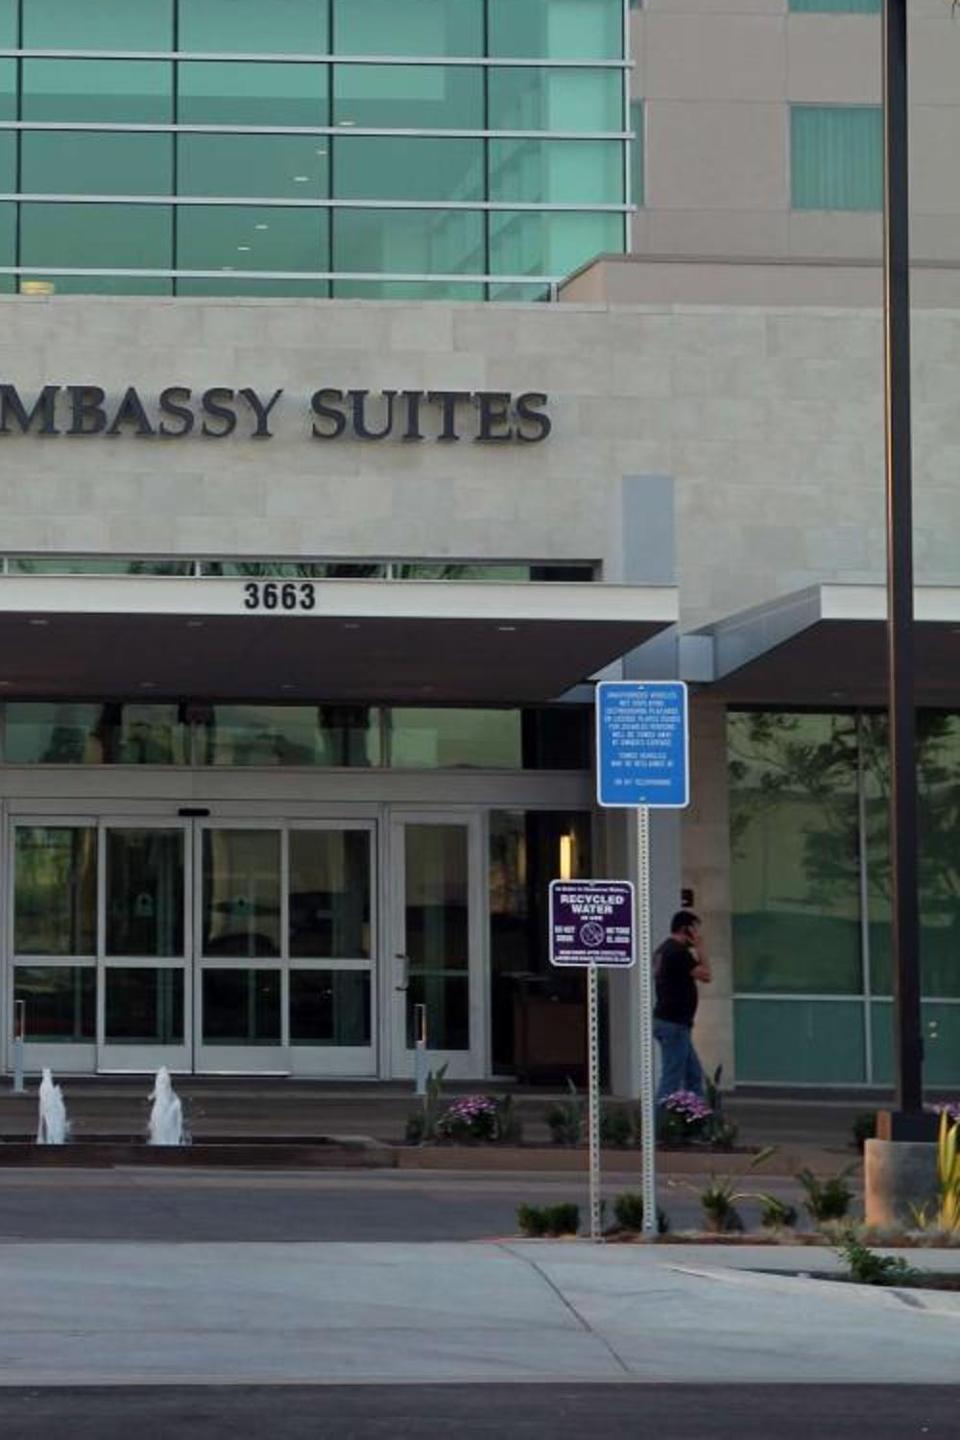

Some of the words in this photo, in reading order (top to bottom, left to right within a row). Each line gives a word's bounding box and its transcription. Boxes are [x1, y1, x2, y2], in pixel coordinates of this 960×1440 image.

[310, 388, 552, 443] SUITES
[244, 583, 315, 610] 3663
[560, 894, 624, 905] RECYCLED
[571, 904, 613, 914] WATER
